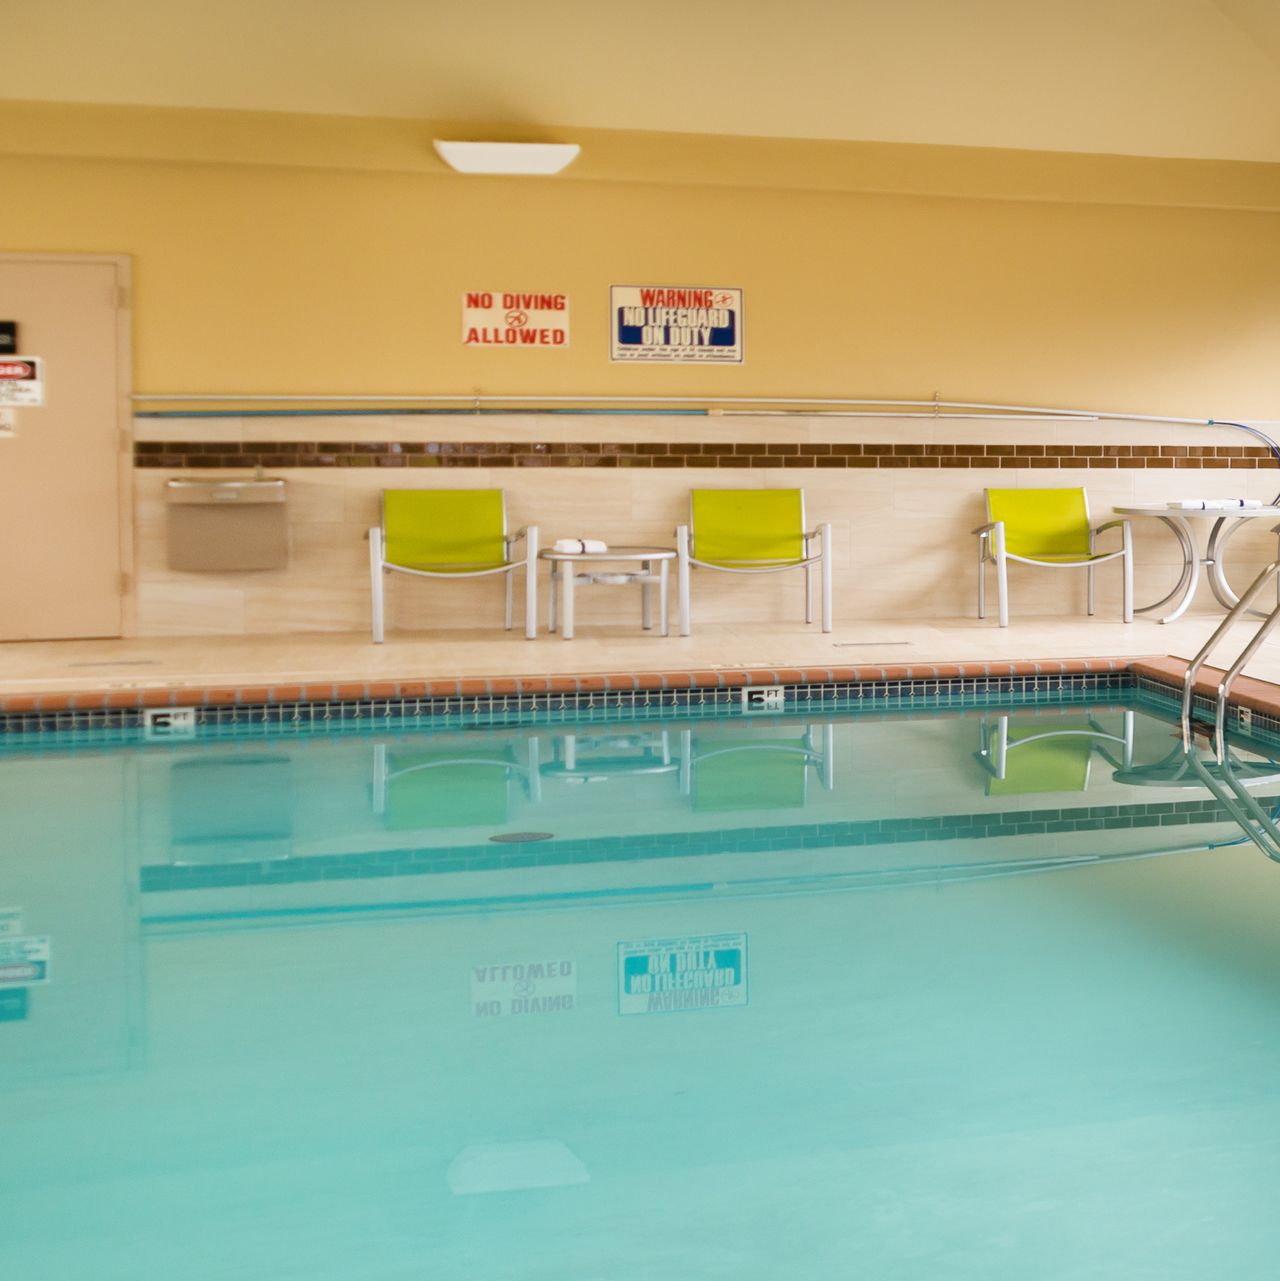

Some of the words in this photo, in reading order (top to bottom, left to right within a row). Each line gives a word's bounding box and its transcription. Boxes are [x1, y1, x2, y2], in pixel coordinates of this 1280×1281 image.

[466, 293, 492, 309] NO
[502, 294, 566, 310] DIVING
[641, 288, 713, 308] WARNING
[623, 306, 645, 326] NO
[647, 307, 729, 328] LIFEGUARD
[467, 328, 564, 344] ALLOWED
[642, 326, 664, 345] ON
[669, 326, 712, 346] DUTY
[748, 690, 764, 704] 5
[767, 689, 779, 698] FT
